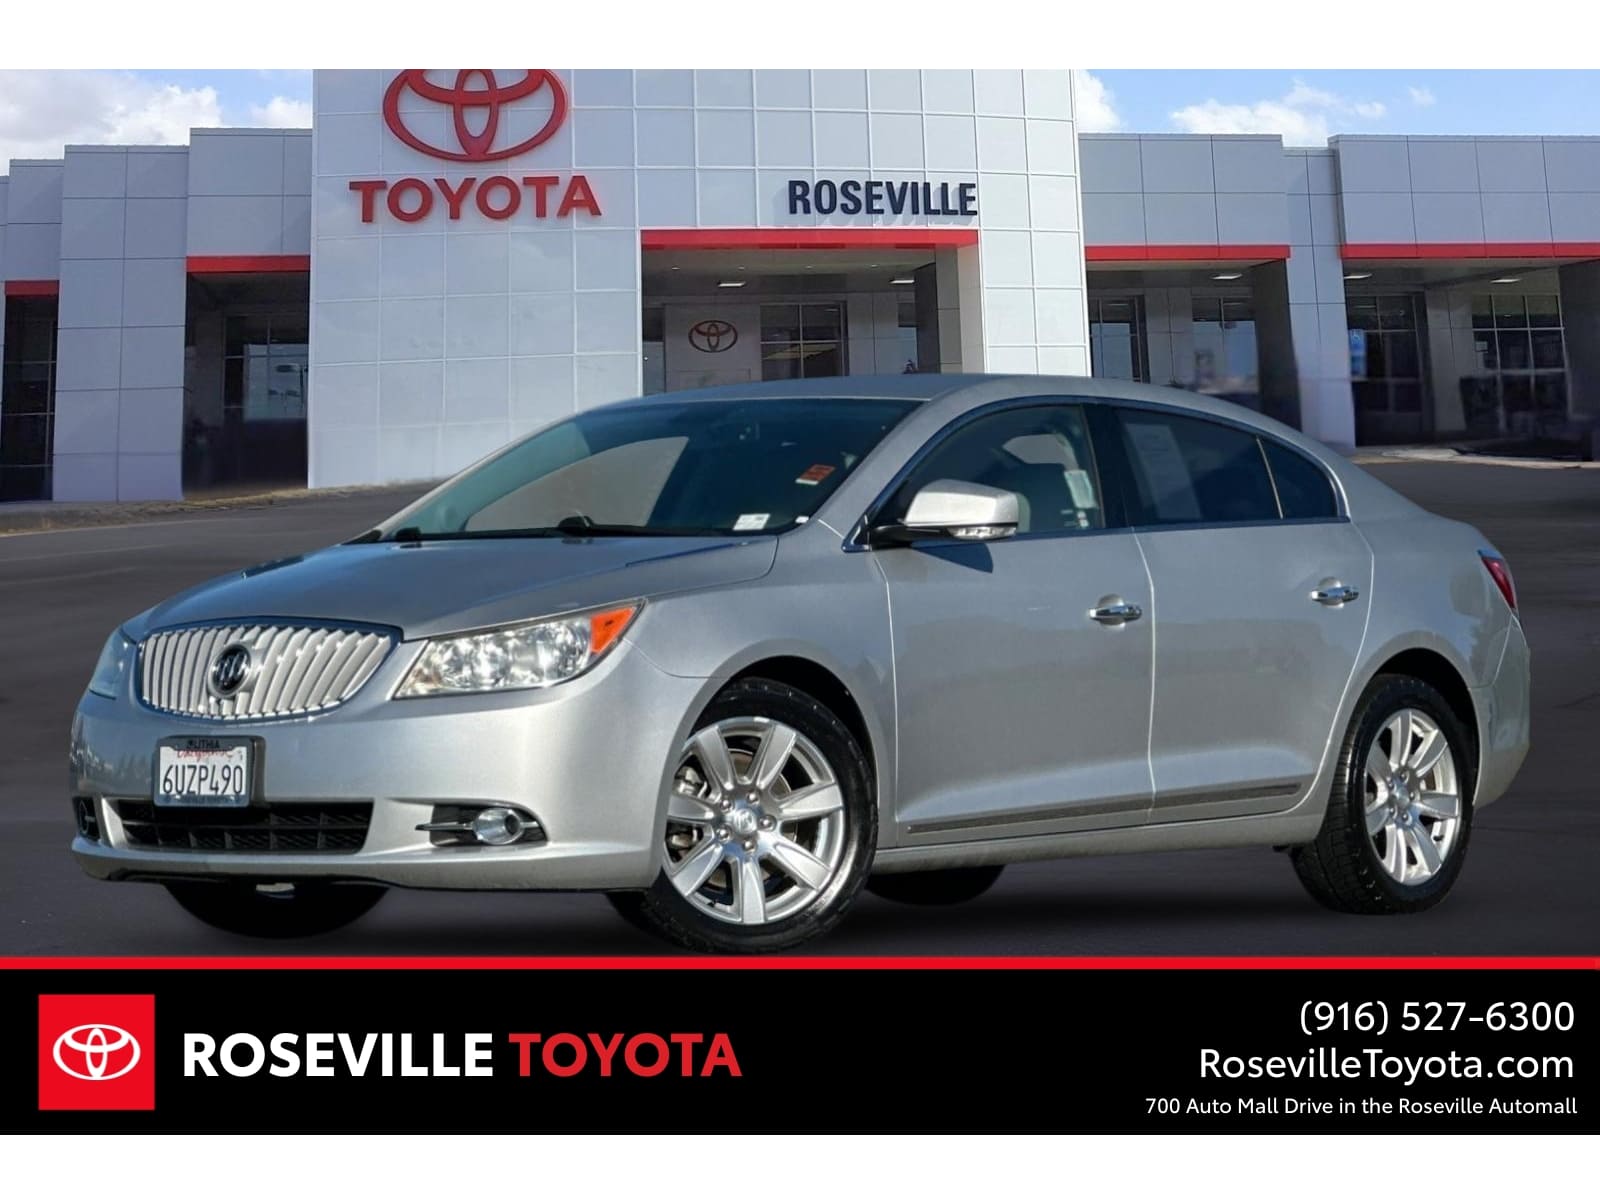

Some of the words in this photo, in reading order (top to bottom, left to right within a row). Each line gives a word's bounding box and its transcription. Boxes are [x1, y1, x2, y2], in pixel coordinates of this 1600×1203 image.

[349, 175, 602, 223] TOYOTA
[789, 179, 978, 216] ROSEVILLE
[163, 764, 243, 795] 6UZP490
